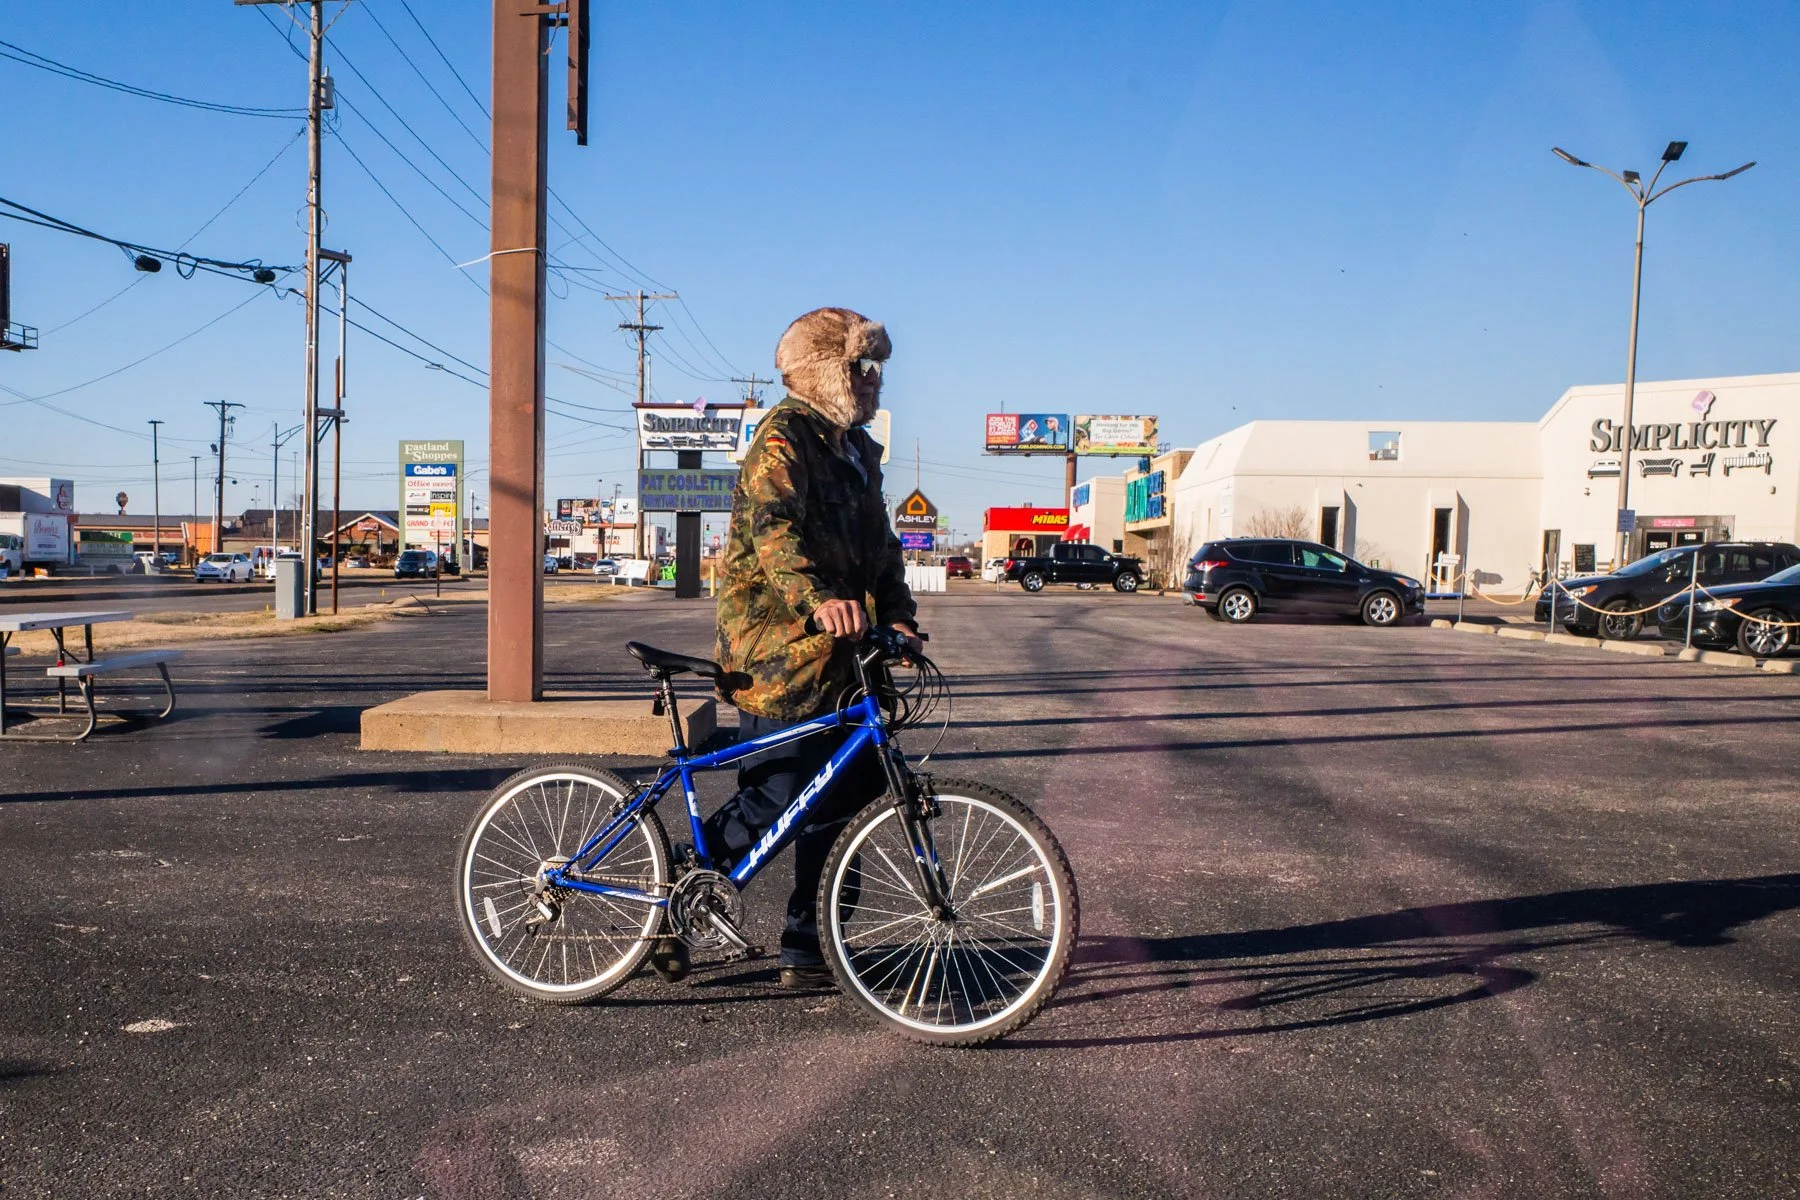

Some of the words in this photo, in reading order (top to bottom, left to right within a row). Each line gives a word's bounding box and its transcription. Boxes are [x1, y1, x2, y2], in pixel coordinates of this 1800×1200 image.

[643, 413, 740, 432] SIMPLICITY
[1590, 418, 1777, 453] SIMPLICITY
[405, 442, 449, 455] Eastland
[413, 451, 458, 462] Shoppes
[413, 465, 447, 475] Gabe's
[641, 475, 664, 490] PAT
[668, 475, 736, 490] COSLETT'S
[897, 514, 937, 523] ASHLEY
[1032, 514, 1068, 525] MIDAS
[750, 760, 834, 868] HUFFY
